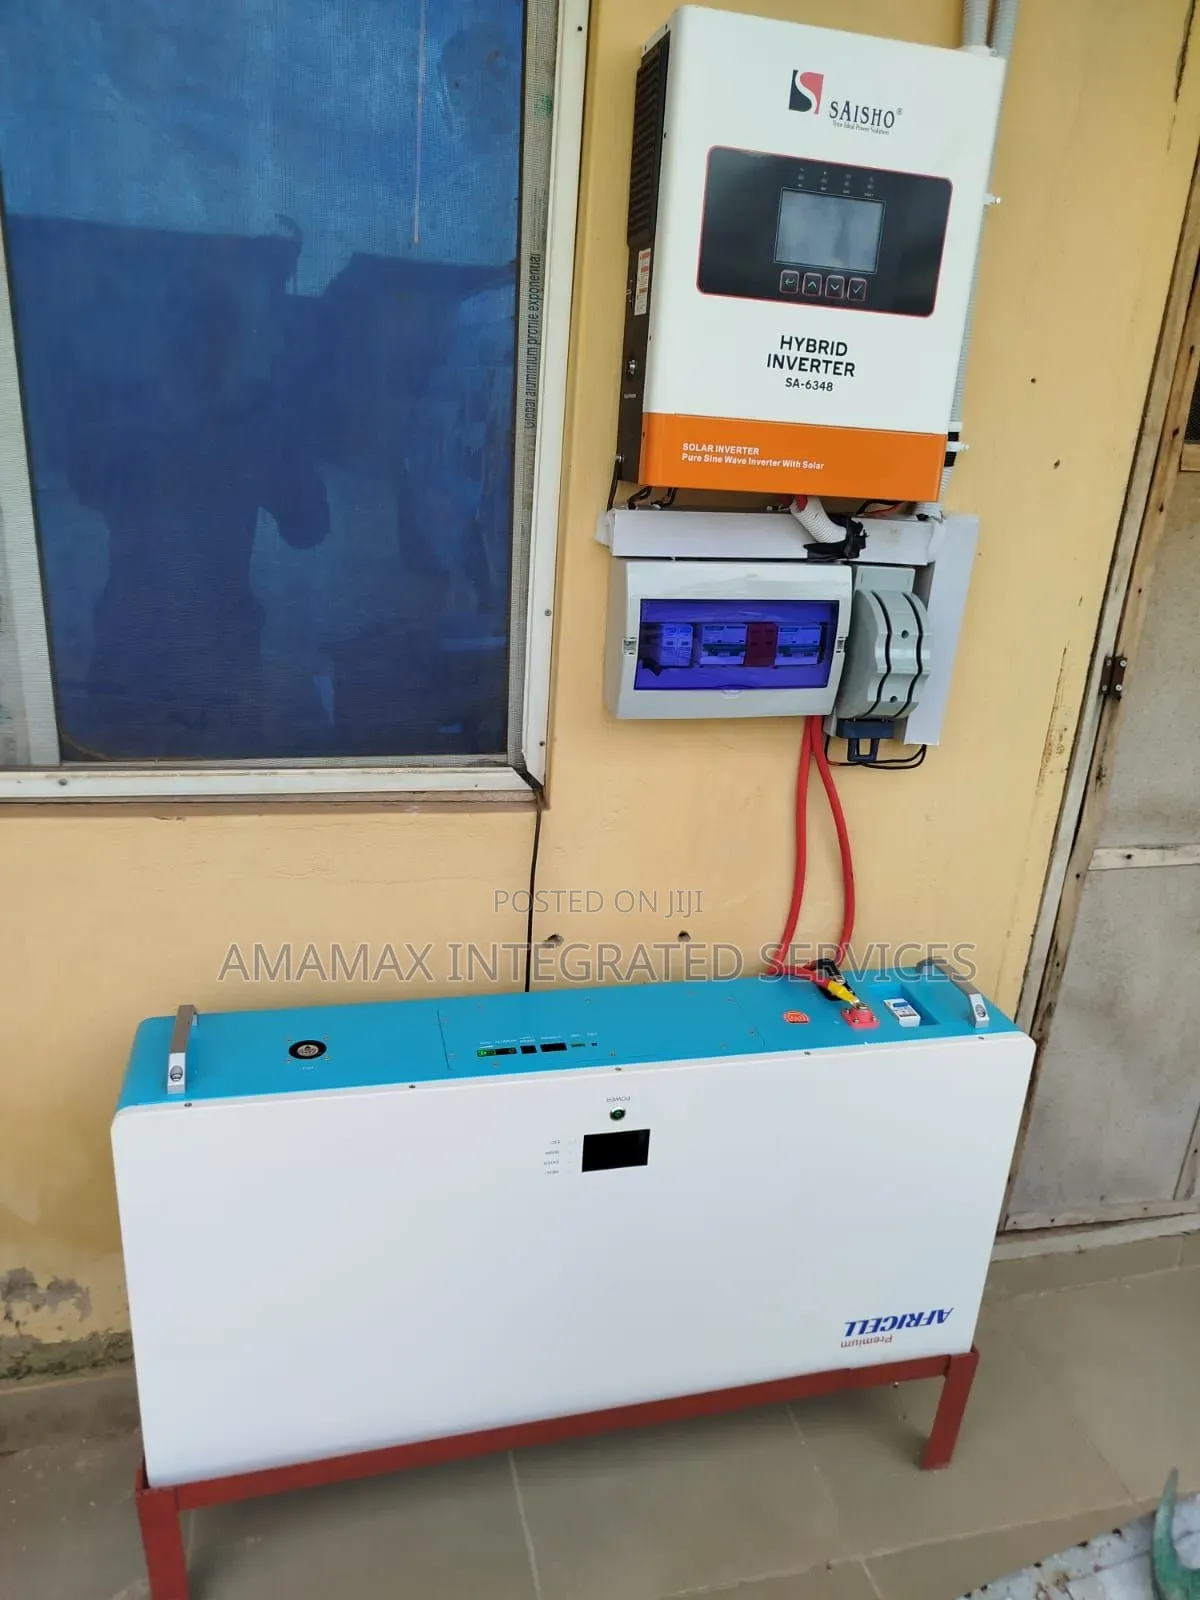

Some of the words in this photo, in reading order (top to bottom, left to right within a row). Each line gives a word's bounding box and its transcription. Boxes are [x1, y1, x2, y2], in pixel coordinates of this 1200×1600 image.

[780, 335, 848, 357] HYBRID
[767, 353, 855, 377] INVERTER
[785, 377, 834, 392] SA-6348
[682, 443, 714, 453] SOLAR
[715, 445, 760, 455] INVERTER
[681, 453, 703, 463] Pure
[703, 454, 723, 464] Sine
[724, 456, 747, 465] Wave
[748, 457, 781, 467] Inverter
[782, 460, 801, 468] With
[802, 461, 825, 470] Solar
[845, 1307, 954, 1337] AFRICELL
[840, 1335, 893, 1348] Premium
